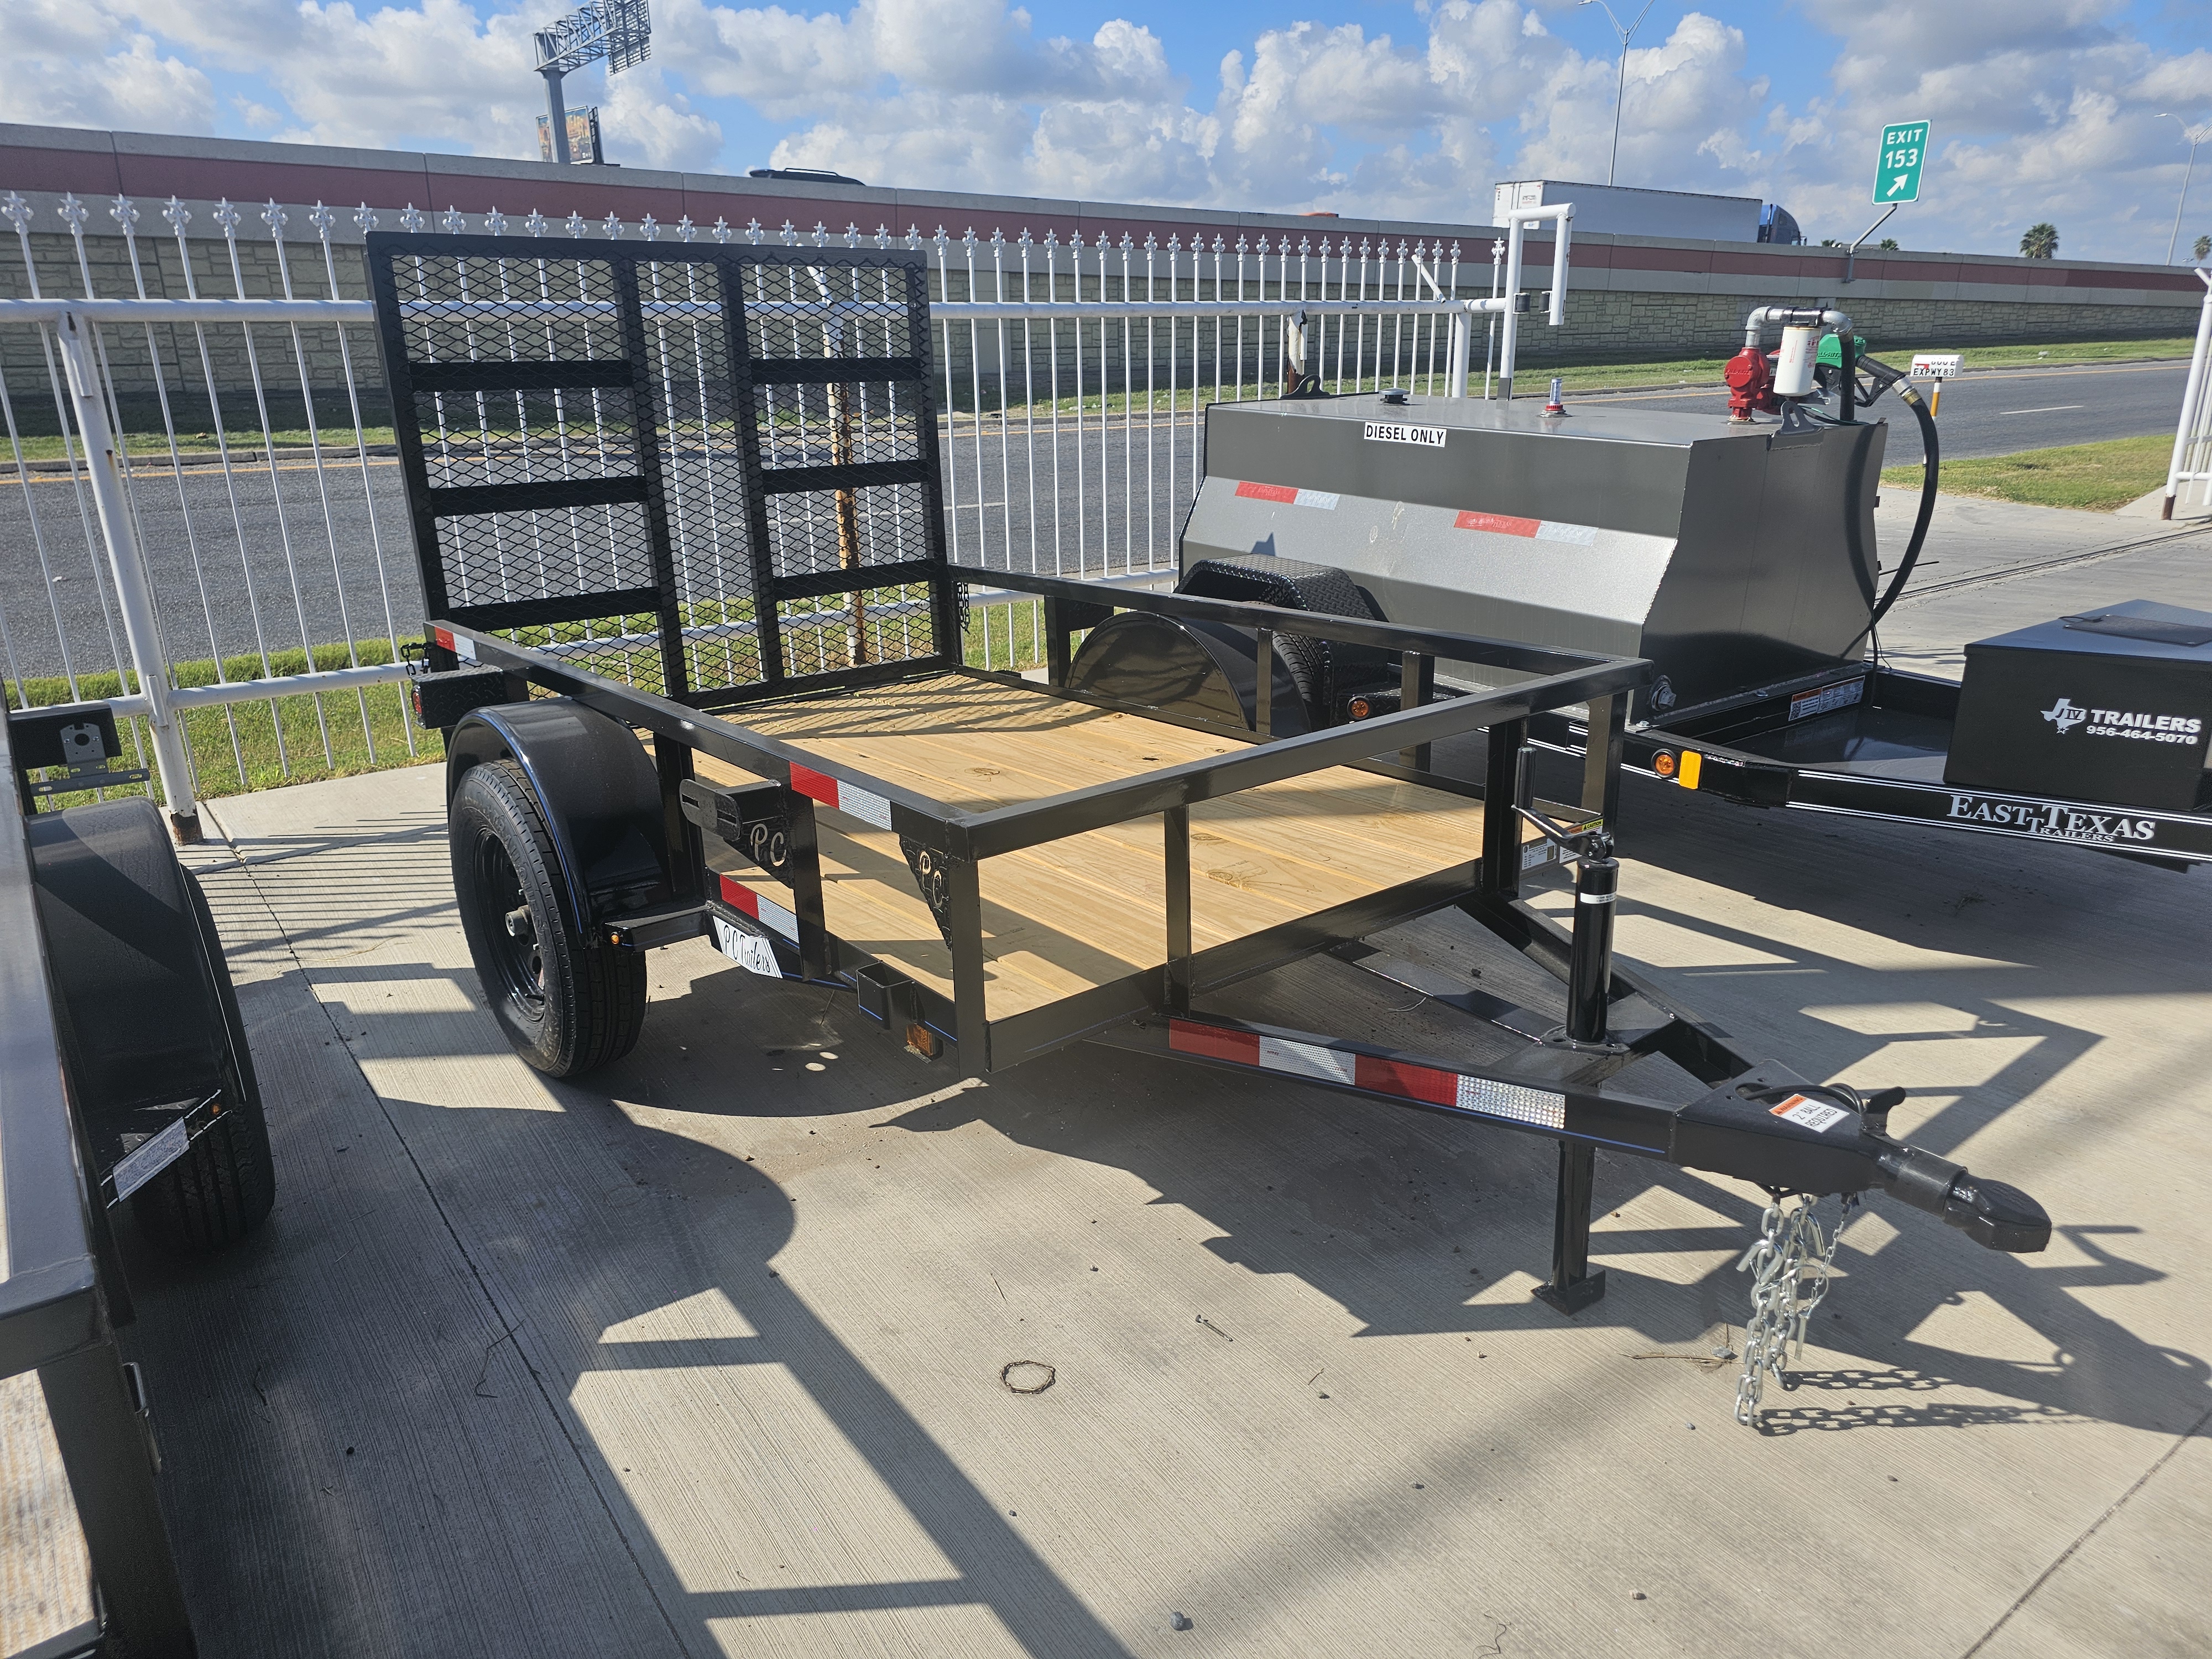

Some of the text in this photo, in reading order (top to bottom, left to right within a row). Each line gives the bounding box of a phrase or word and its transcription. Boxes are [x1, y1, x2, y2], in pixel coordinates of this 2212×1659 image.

[1886, 128, 1923, 145] EXIT
[1885, 148, 1918, 169] 153
[1913, 368, 1942, 376] EXPWY
[1366, 425, 1444, 445] DIESEL ONLY
[2091, 709, 2202, 733] TRAILERS
[2086, 725, 2198, 745] 956-464-5070
[1947, 794, 2156, 841] EAST TEXAS
[2025, 817, 2114, 843] TRAILERS
[1780, 1097, 1803, 1112] WARNING
[1792, 1104, 1822, 1120] 2" BALL
[1804, 1108, 1838, 1128] REQUIRED
